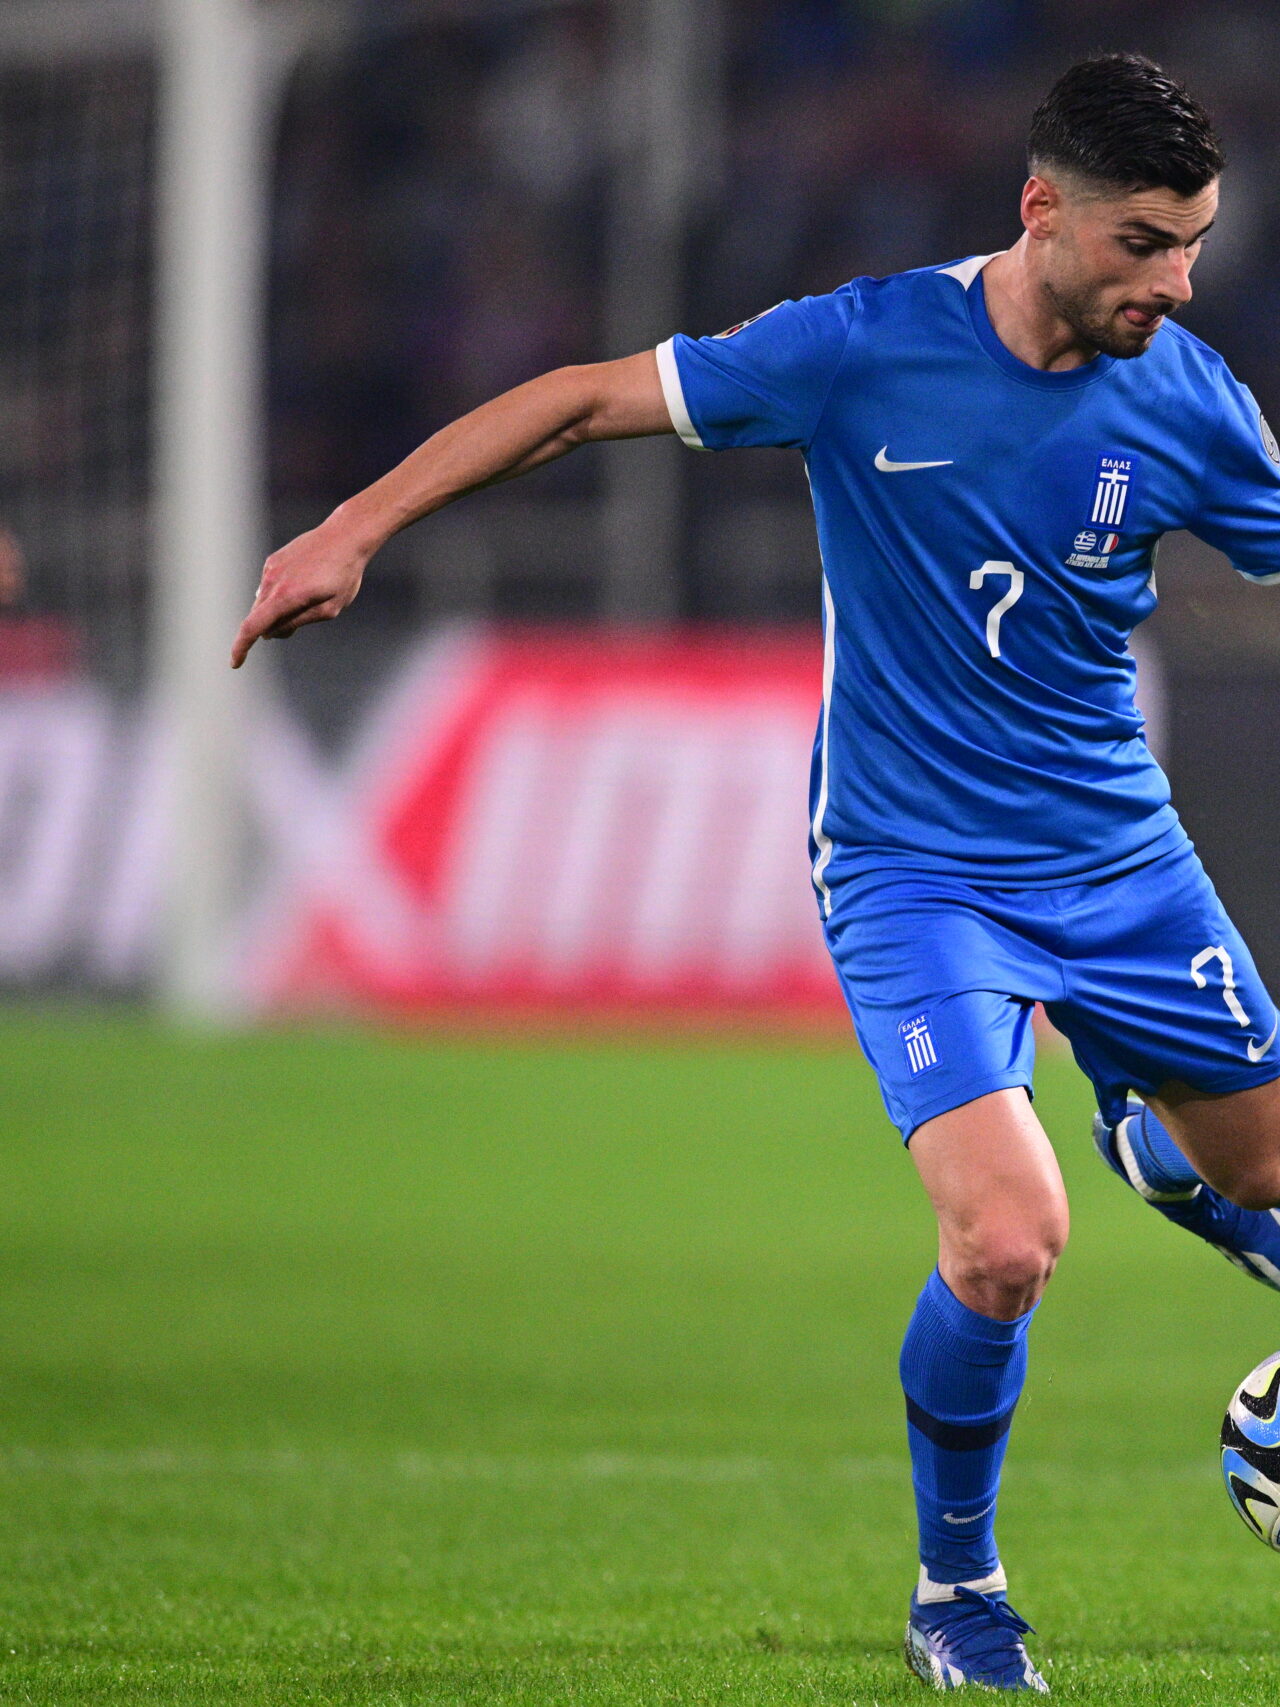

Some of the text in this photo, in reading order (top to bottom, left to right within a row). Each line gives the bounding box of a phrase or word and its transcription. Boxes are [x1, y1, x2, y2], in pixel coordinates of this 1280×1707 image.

[1101, 458, 1131, 470] ΕΛΛΑΣ
[969, 560, 1024, 658] 7
[1190, 945, 1251, 1028] 7
